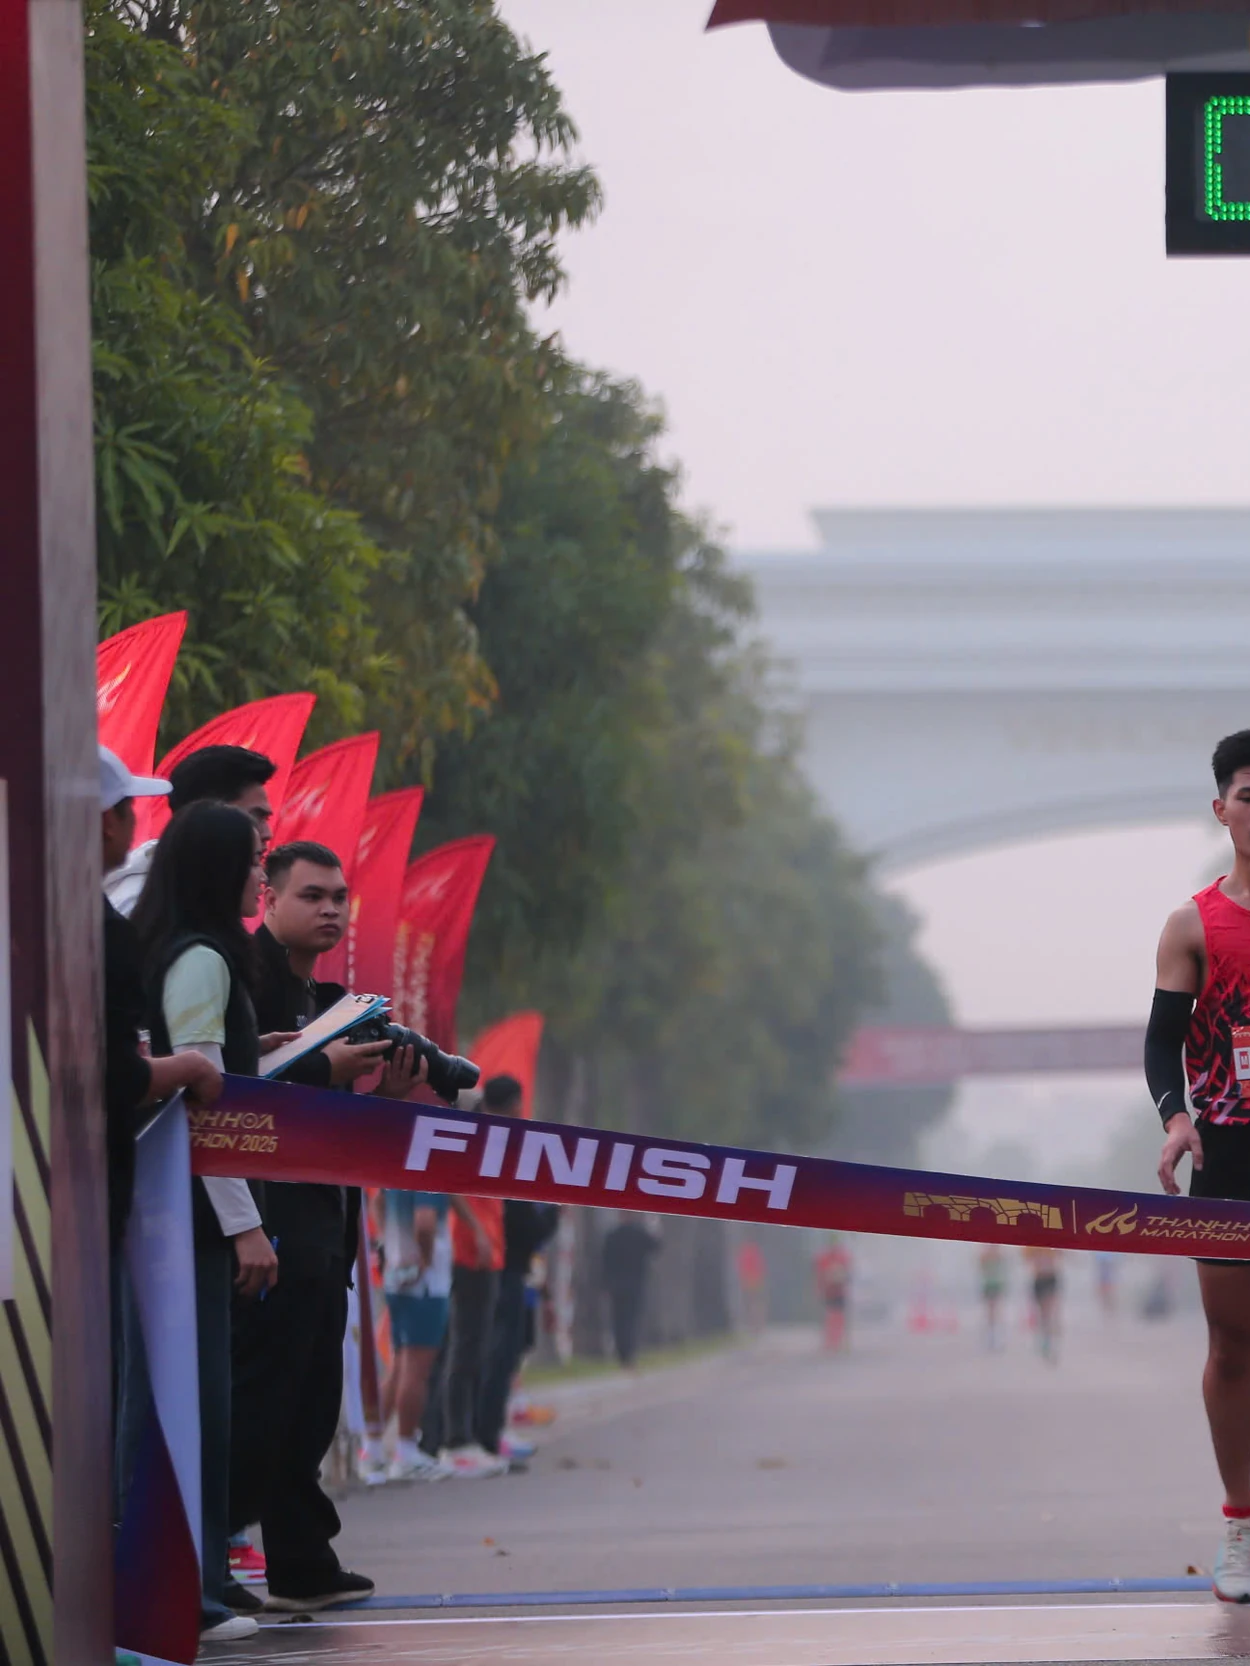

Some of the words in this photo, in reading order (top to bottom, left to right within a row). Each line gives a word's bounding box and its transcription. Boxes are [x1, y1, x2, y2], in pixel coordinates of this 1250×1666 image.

[239, 1134, 280, 1153] 2025
[405, 1115, 798, 1210] FINISH
[1139, 1228, 1250, 1242] MARATHON
